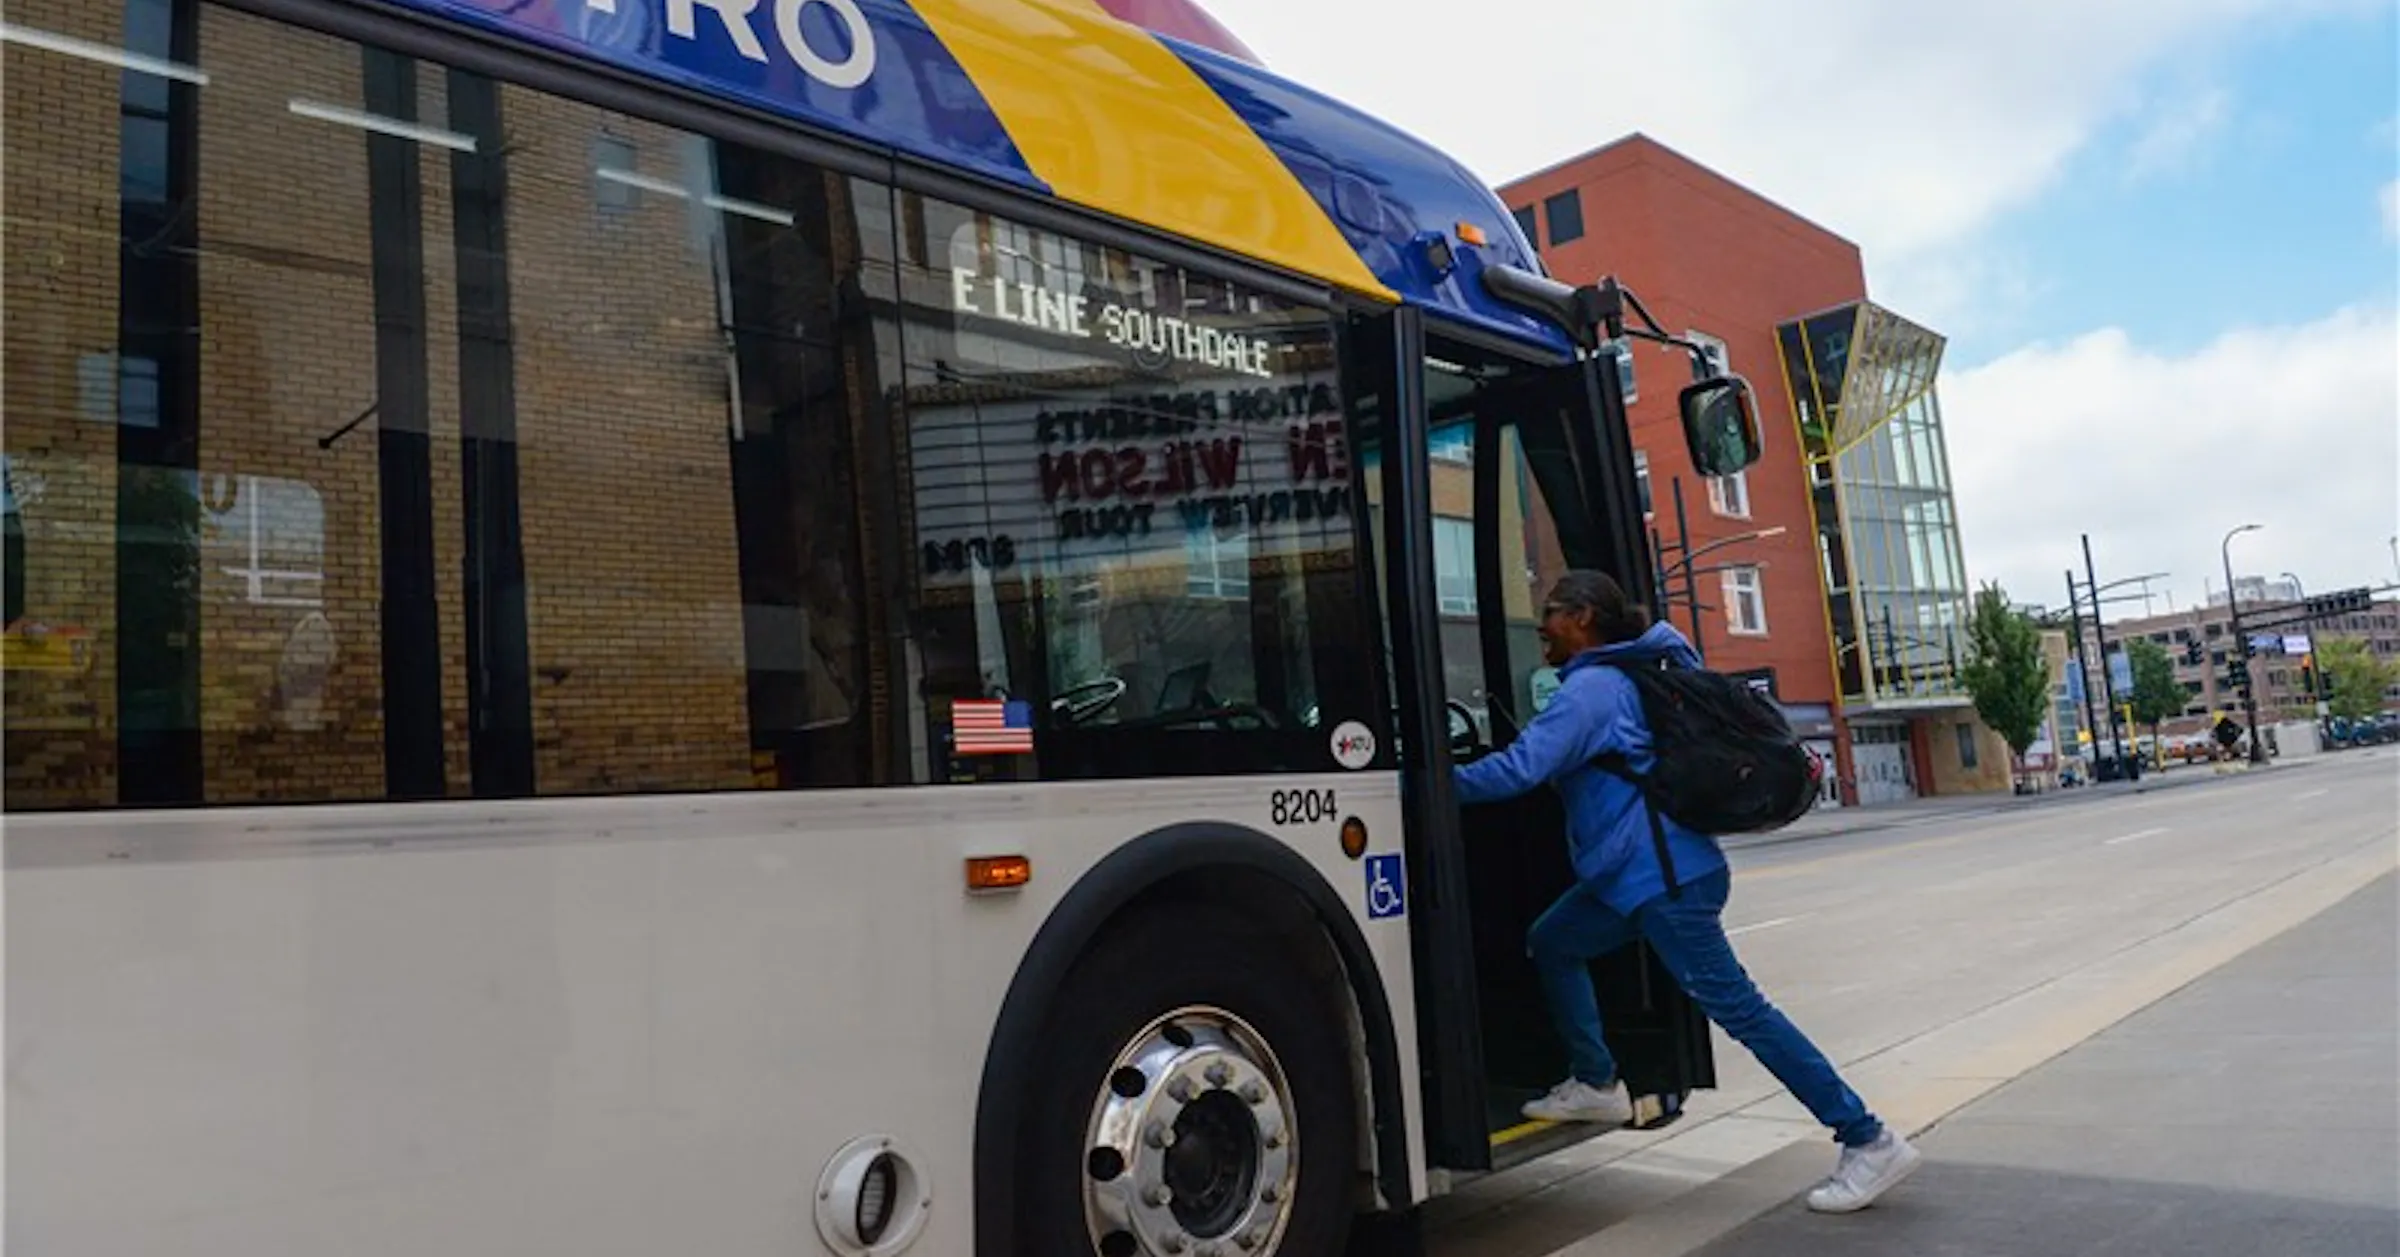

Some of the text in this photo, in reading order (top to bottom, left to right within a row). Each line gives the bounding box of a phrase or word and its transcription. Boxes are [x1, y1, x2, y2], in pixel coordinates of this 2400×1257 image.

[586, 0, 876, 88] RO
[952, 266, 1272, 378] E LINE SOUTHDALE
[1271, 789, 1337, 825] 8204
